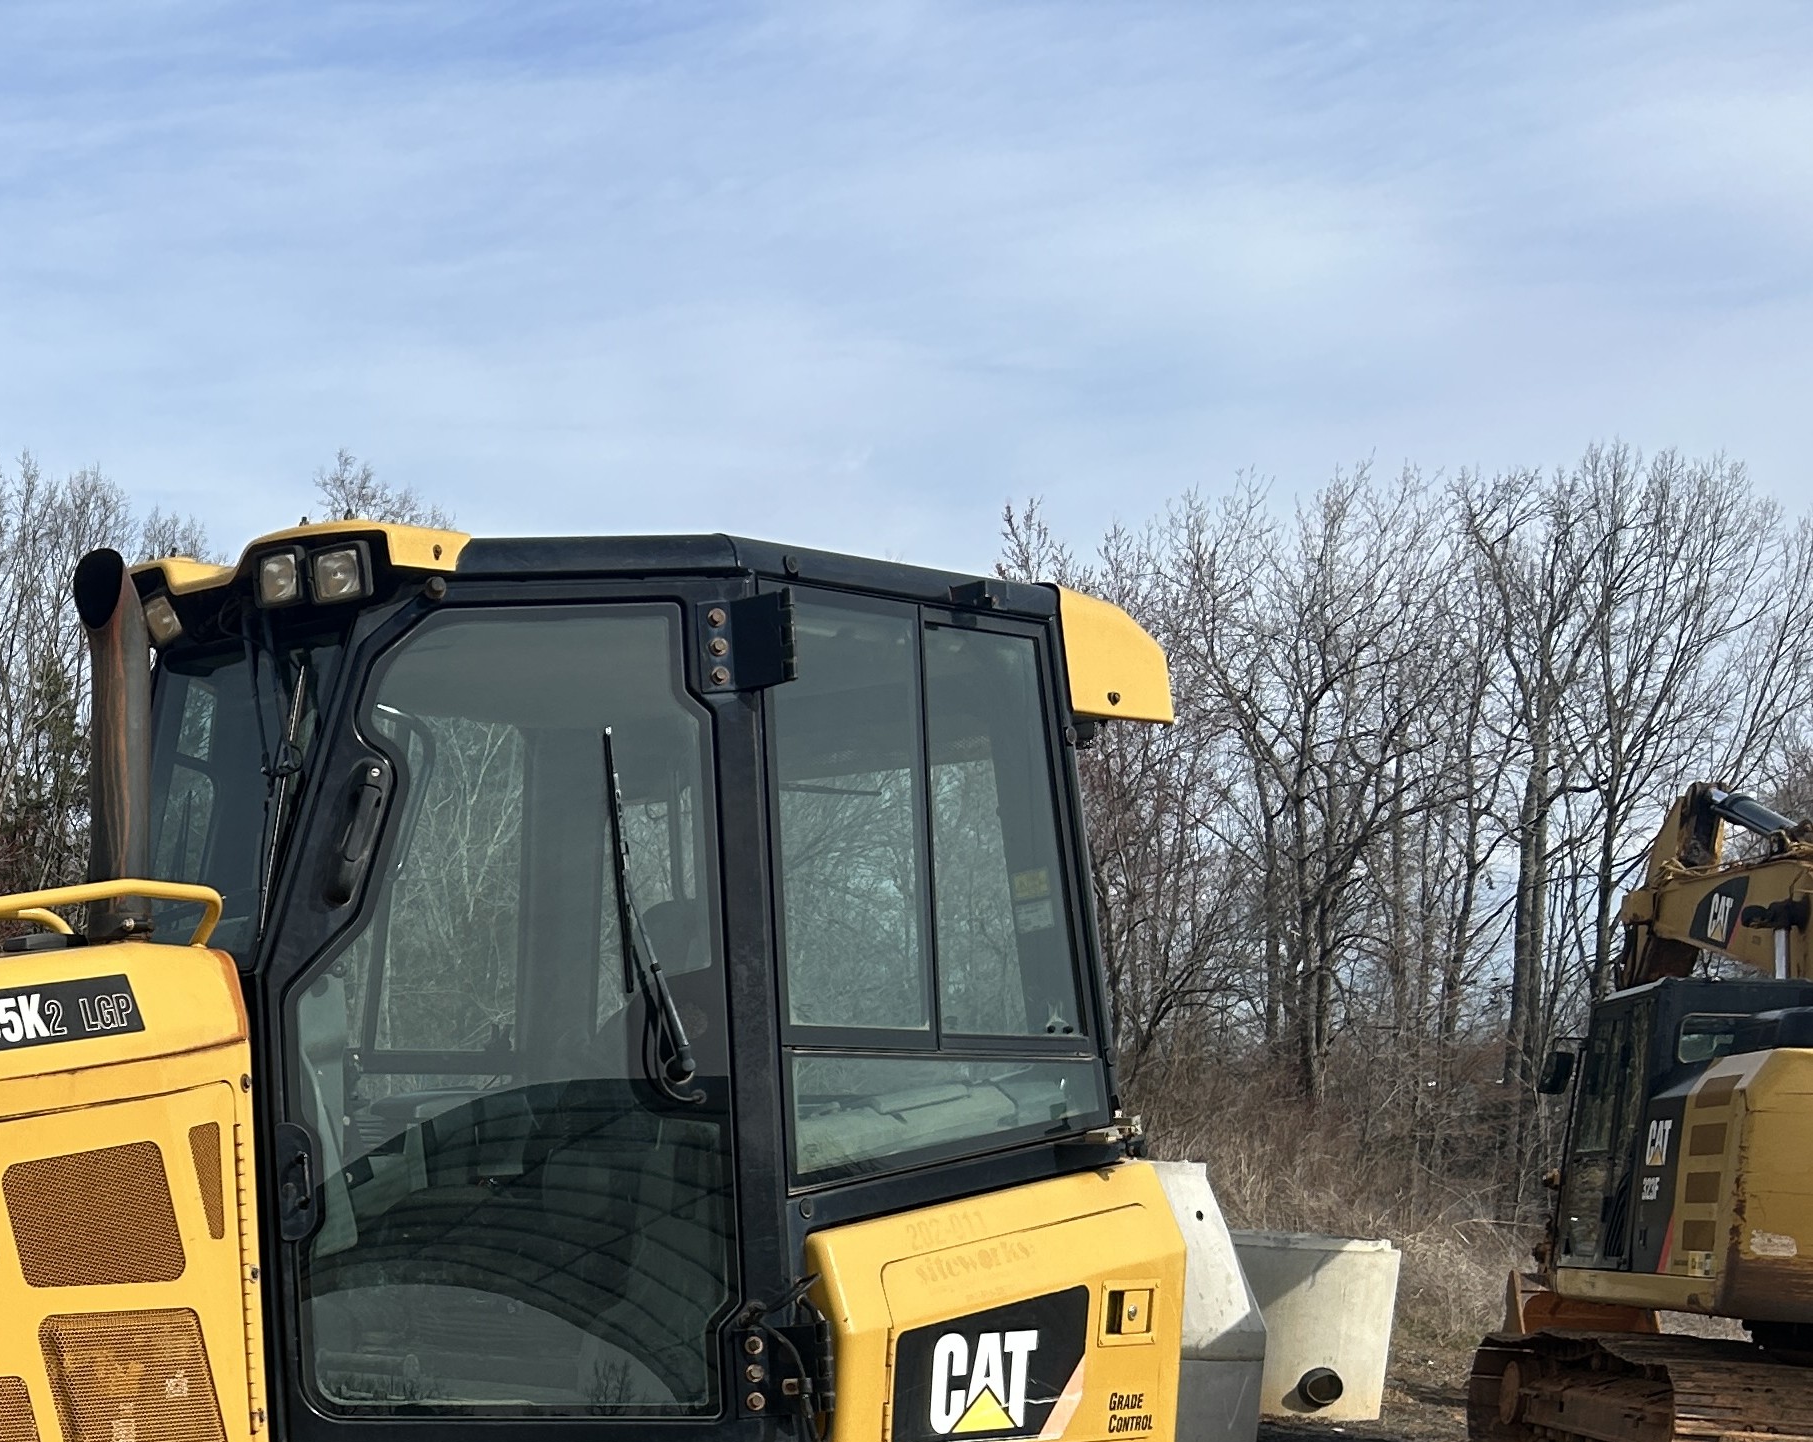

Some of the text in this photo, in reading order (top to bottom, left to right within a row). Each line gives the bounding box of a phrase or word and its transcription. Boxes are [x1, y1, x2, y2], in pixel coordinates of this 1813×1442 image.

[1707, 892, 1735, 942] CAT
[78, 993, 133, 1032] LGP
[1645, 1120, 1673, 1166] CAT
[929, 1329, 1039, 1435] CAT
